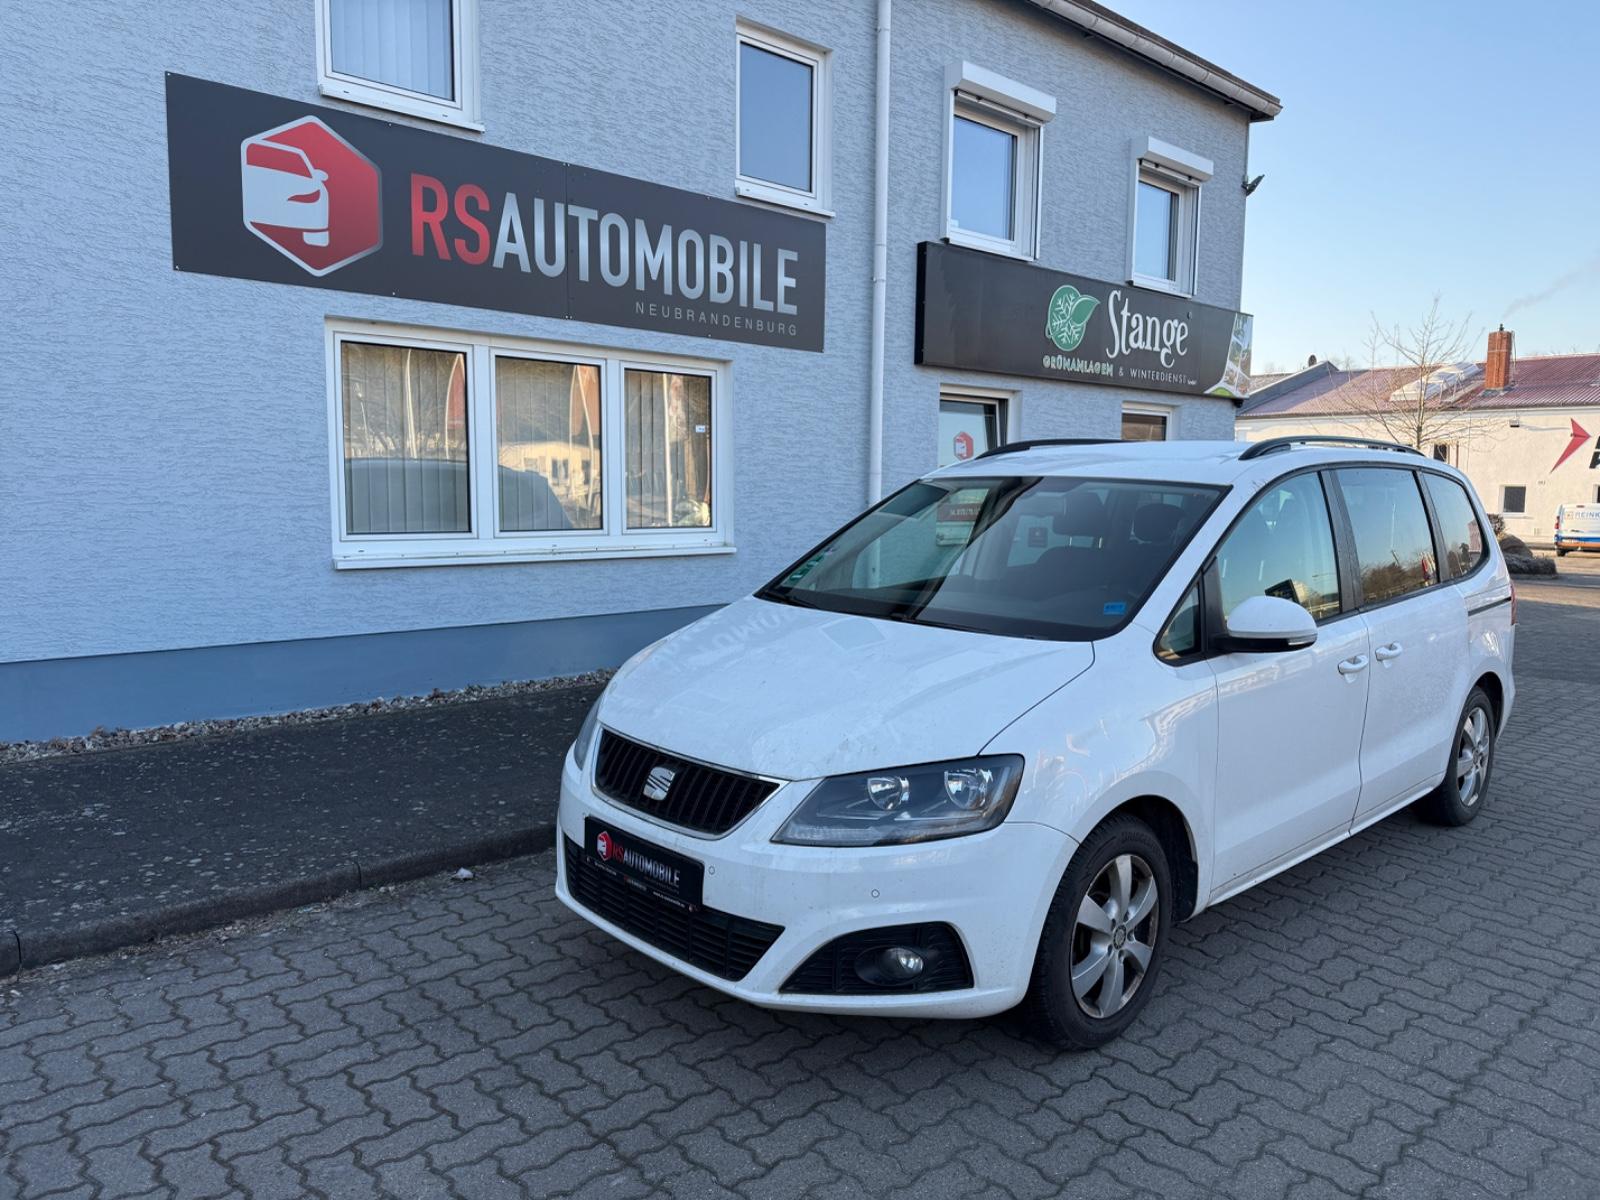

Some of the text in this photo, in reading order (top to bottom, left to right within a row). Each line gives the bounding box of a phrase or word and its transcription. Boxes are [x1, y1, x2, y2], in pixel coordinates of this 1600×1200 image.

[635, 301, 798, 337] NEUBRANDENBURG
[1106, 290, 1189, 368] Stange
[1042, 354, 1187, 385] GRÜNANLAGEN & WINTERDIENST
